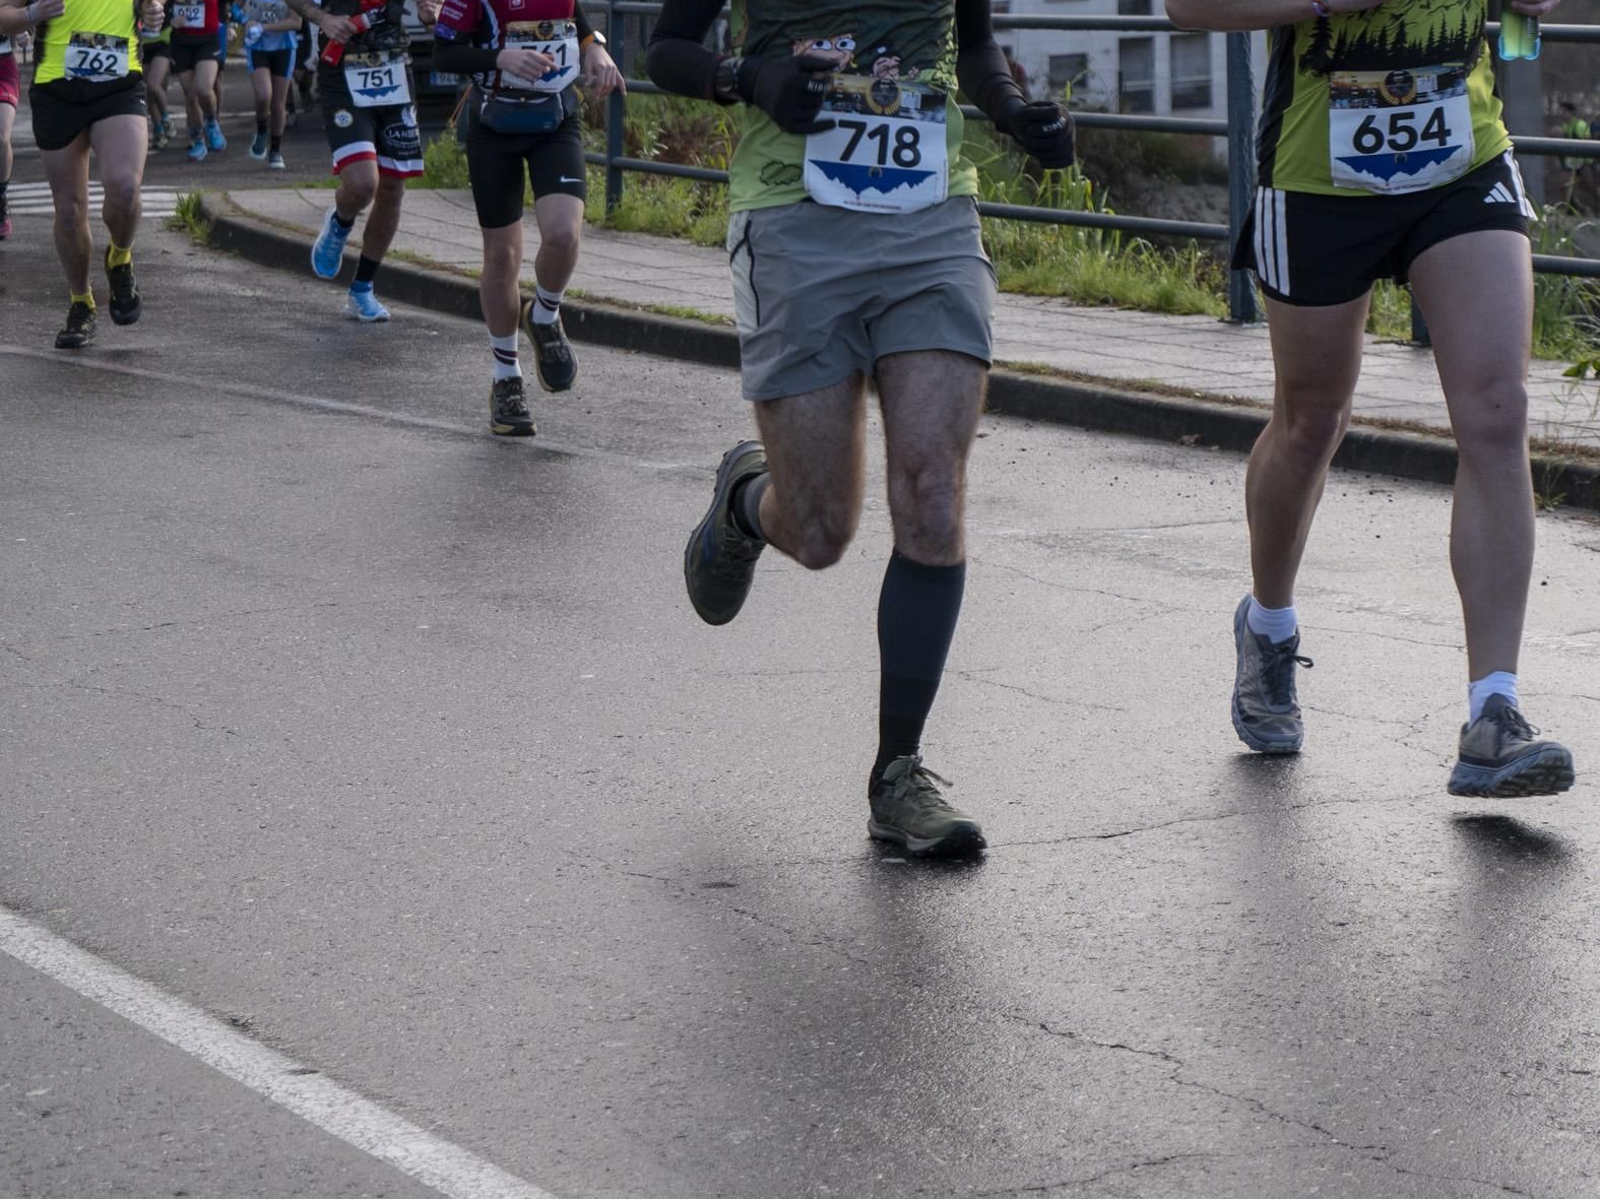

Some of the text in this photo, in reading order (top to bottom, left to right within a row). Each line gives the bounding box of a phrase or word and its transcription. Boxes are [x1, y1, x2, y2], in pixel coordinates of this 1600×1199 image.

[77, 49, 118, 74] 762
[358, 68, 394, 88] 751
[838, 119, 922, 168] 718
[1353, 106, 1452, 154] 654
